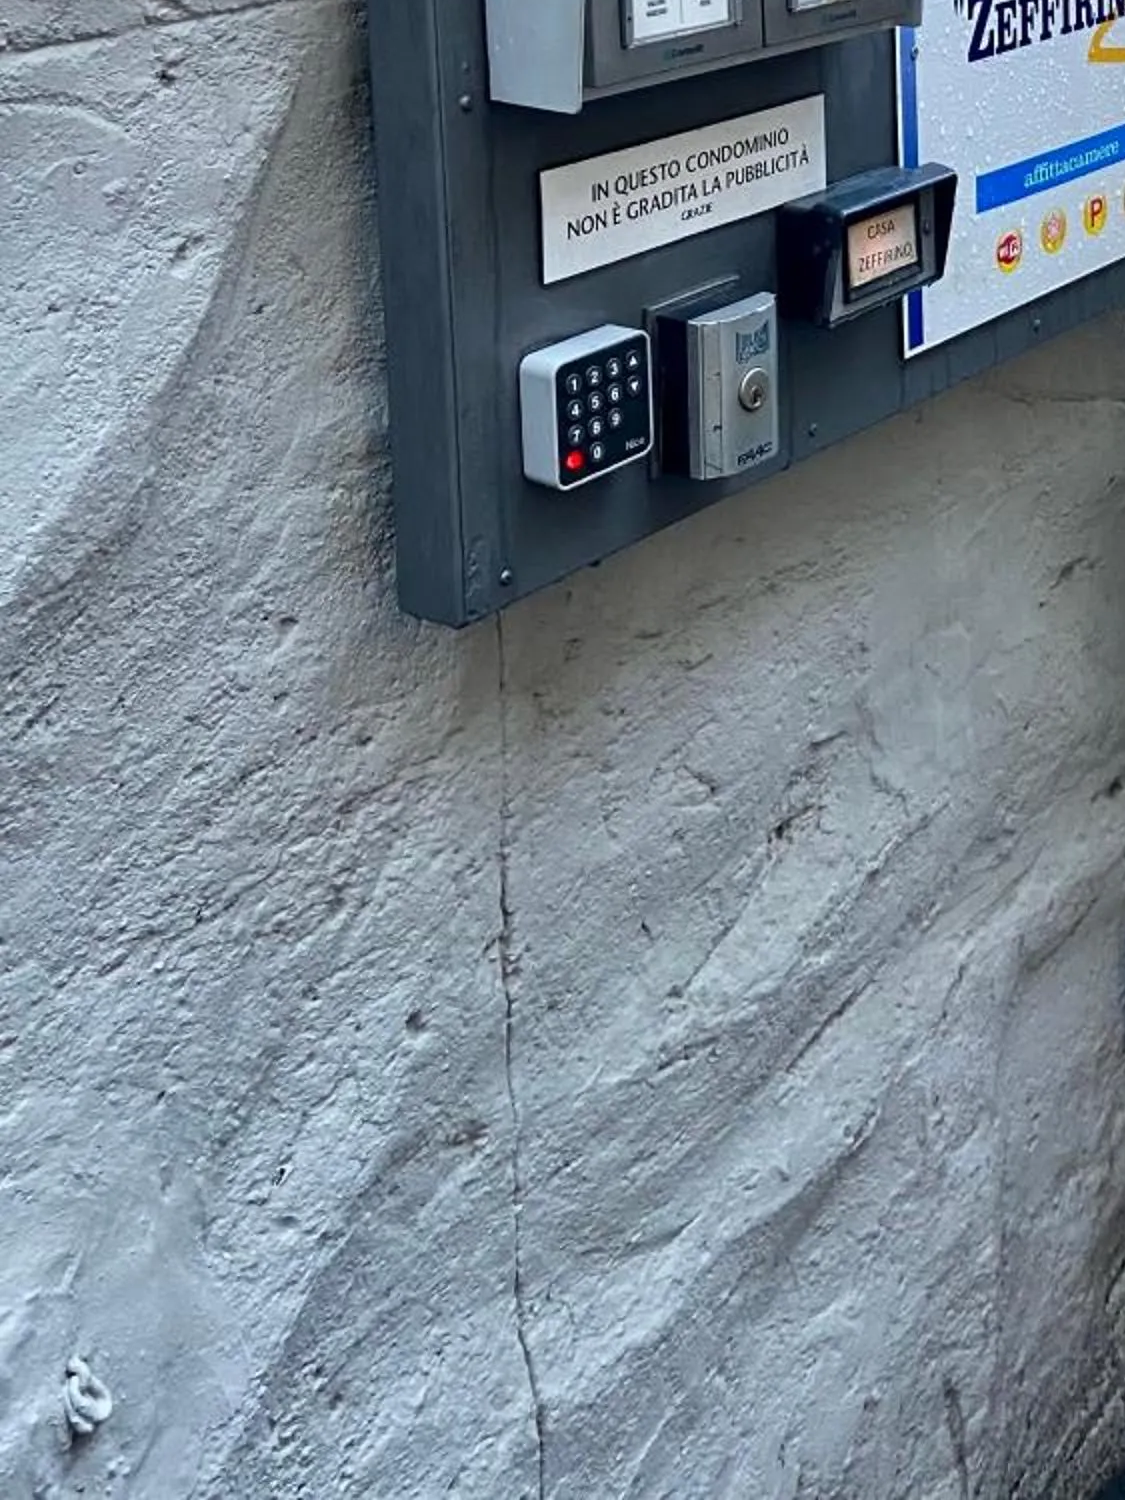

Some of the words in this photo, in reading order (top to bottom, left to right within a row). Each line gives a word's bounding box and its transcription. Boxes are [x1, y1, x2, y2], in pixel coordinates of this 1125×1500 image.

[591, 179, 609, 203] IN
[614, 158, 682, 197] QUESTO
[685, 127, 790, 175] CONDOMINIO
[1023, 140, 1121, 189] affittacamere
[566, 209, 608, 240] NON
[612, 201, 622, 226] È
[626, 182, 698, 221] GRADITA
[702, 174, 722, 197] LA
[725, 143, 810, 190] PUBBLICITÀ
[681, 201, 714, 222] GRAZIE
[867, 219, 896, 240] CASA
[591, 369, 600, 384] 2
[612, 361, 620, 376] 3
[570, 402, 580, 417] 4
[591, 394, 600, 410] 5
[610, 386, 620, 401] 6
[592, 446, 601, 460] 0
